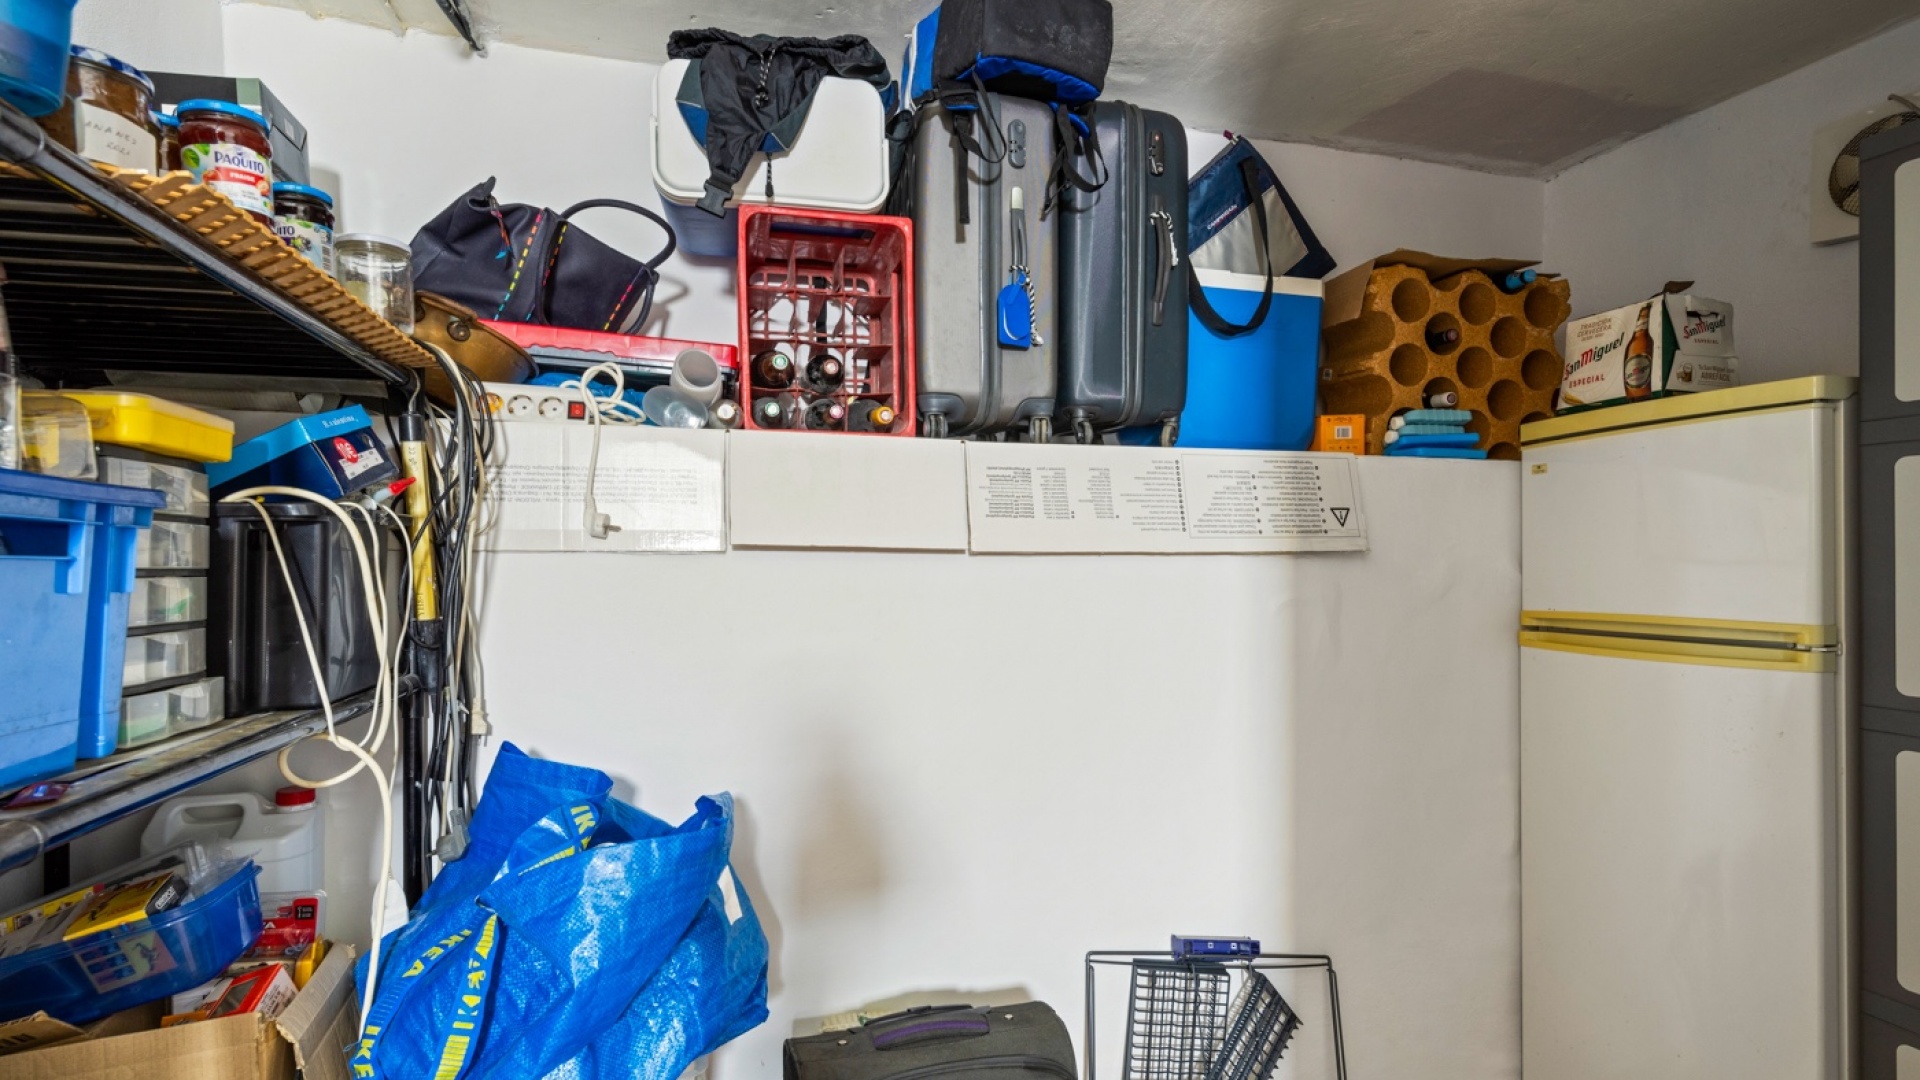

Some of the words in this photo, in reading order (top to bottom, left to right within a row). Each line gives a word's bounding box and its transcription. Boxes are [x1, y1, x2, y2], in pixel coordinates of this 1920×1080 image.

[214, 151, 264, 174] PAQUITO
[1569, 373, 1605, 389] ESPECIAL
[402, 929, 472, 978] IKEA
